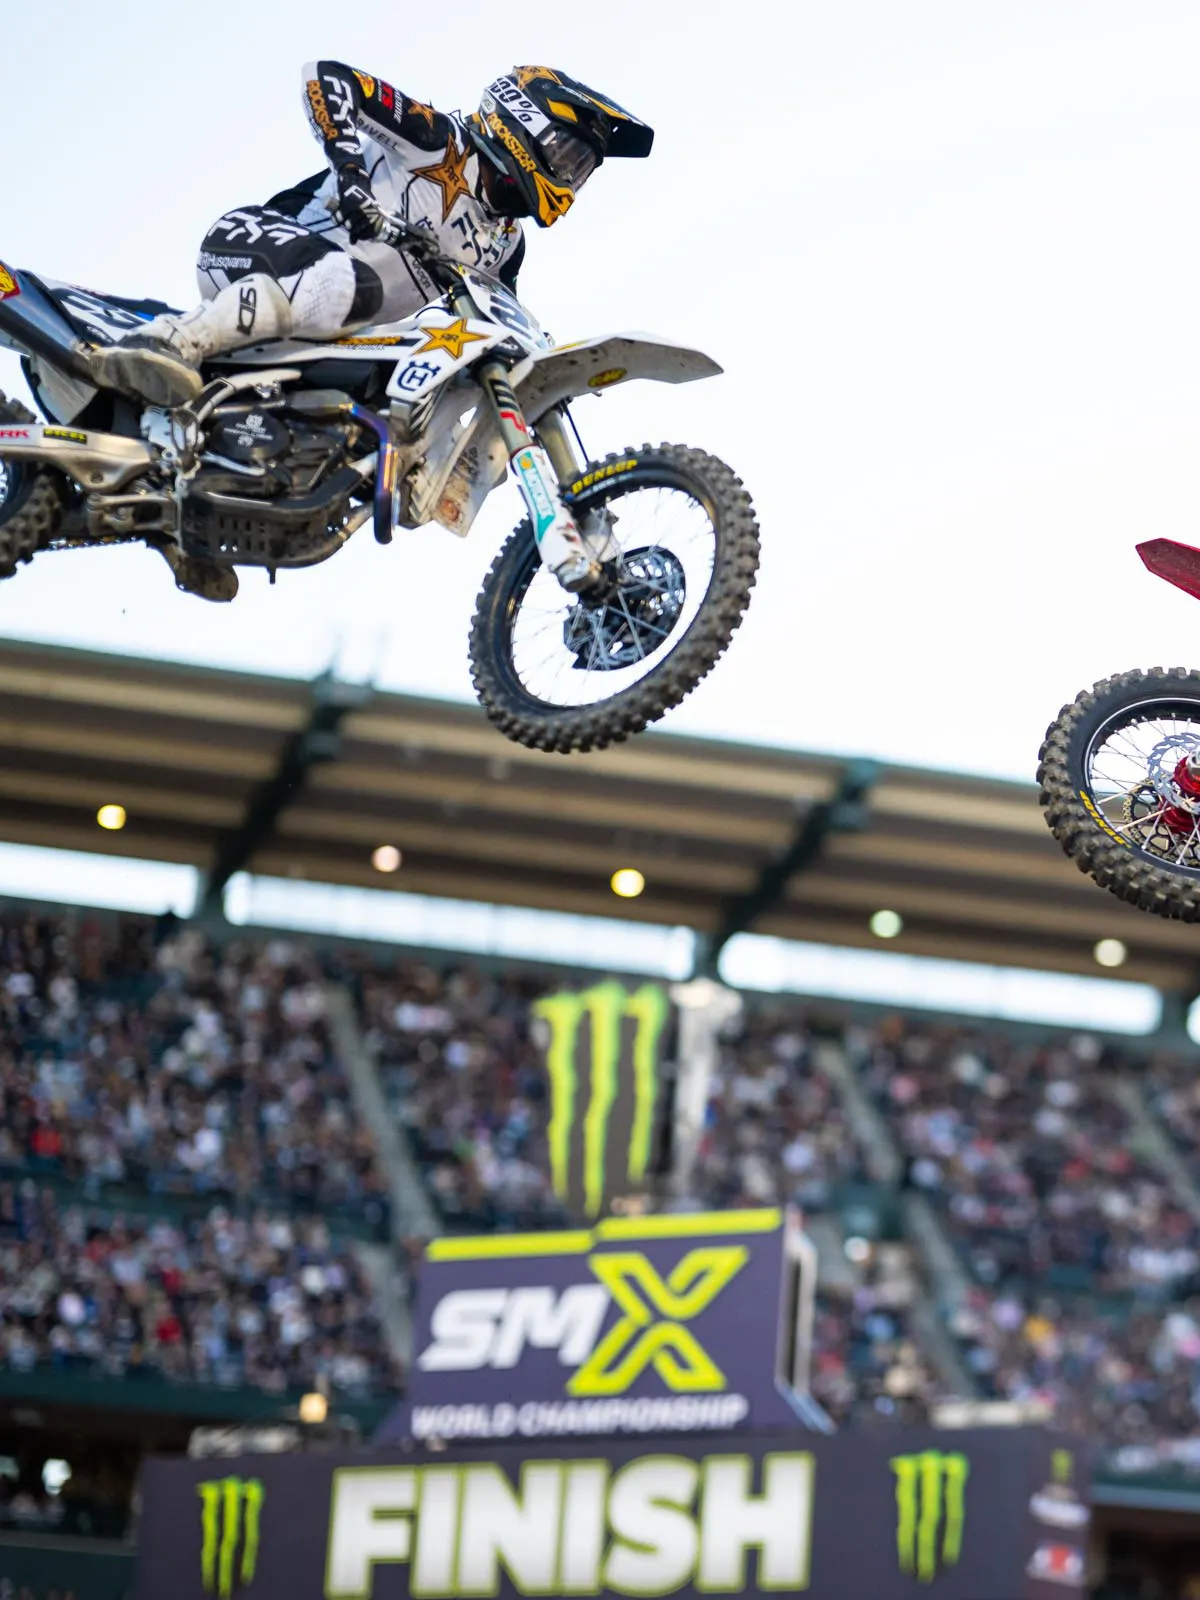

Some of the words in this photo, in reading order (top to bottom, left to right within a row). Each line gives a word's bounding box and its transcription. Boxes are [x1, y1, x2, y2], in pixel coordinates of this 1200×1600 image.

[306, 79, 338, 141] ROCKSTAR
[486, 112, 537, 172] ROCKSTAR
[208, 254, 252, 269] Husqvarna
[572, 459, 638, 496] DUNLOP
[1080, 789, 1131, 848] DUNLOP
[418, 1245, 748, 1395] SMX
[411, 1403, 516, 1439] WORLD
[517, 1393, 750, 1437] CHAMPIONSHIP
[325, 1452, 815, 1598] FINISH
